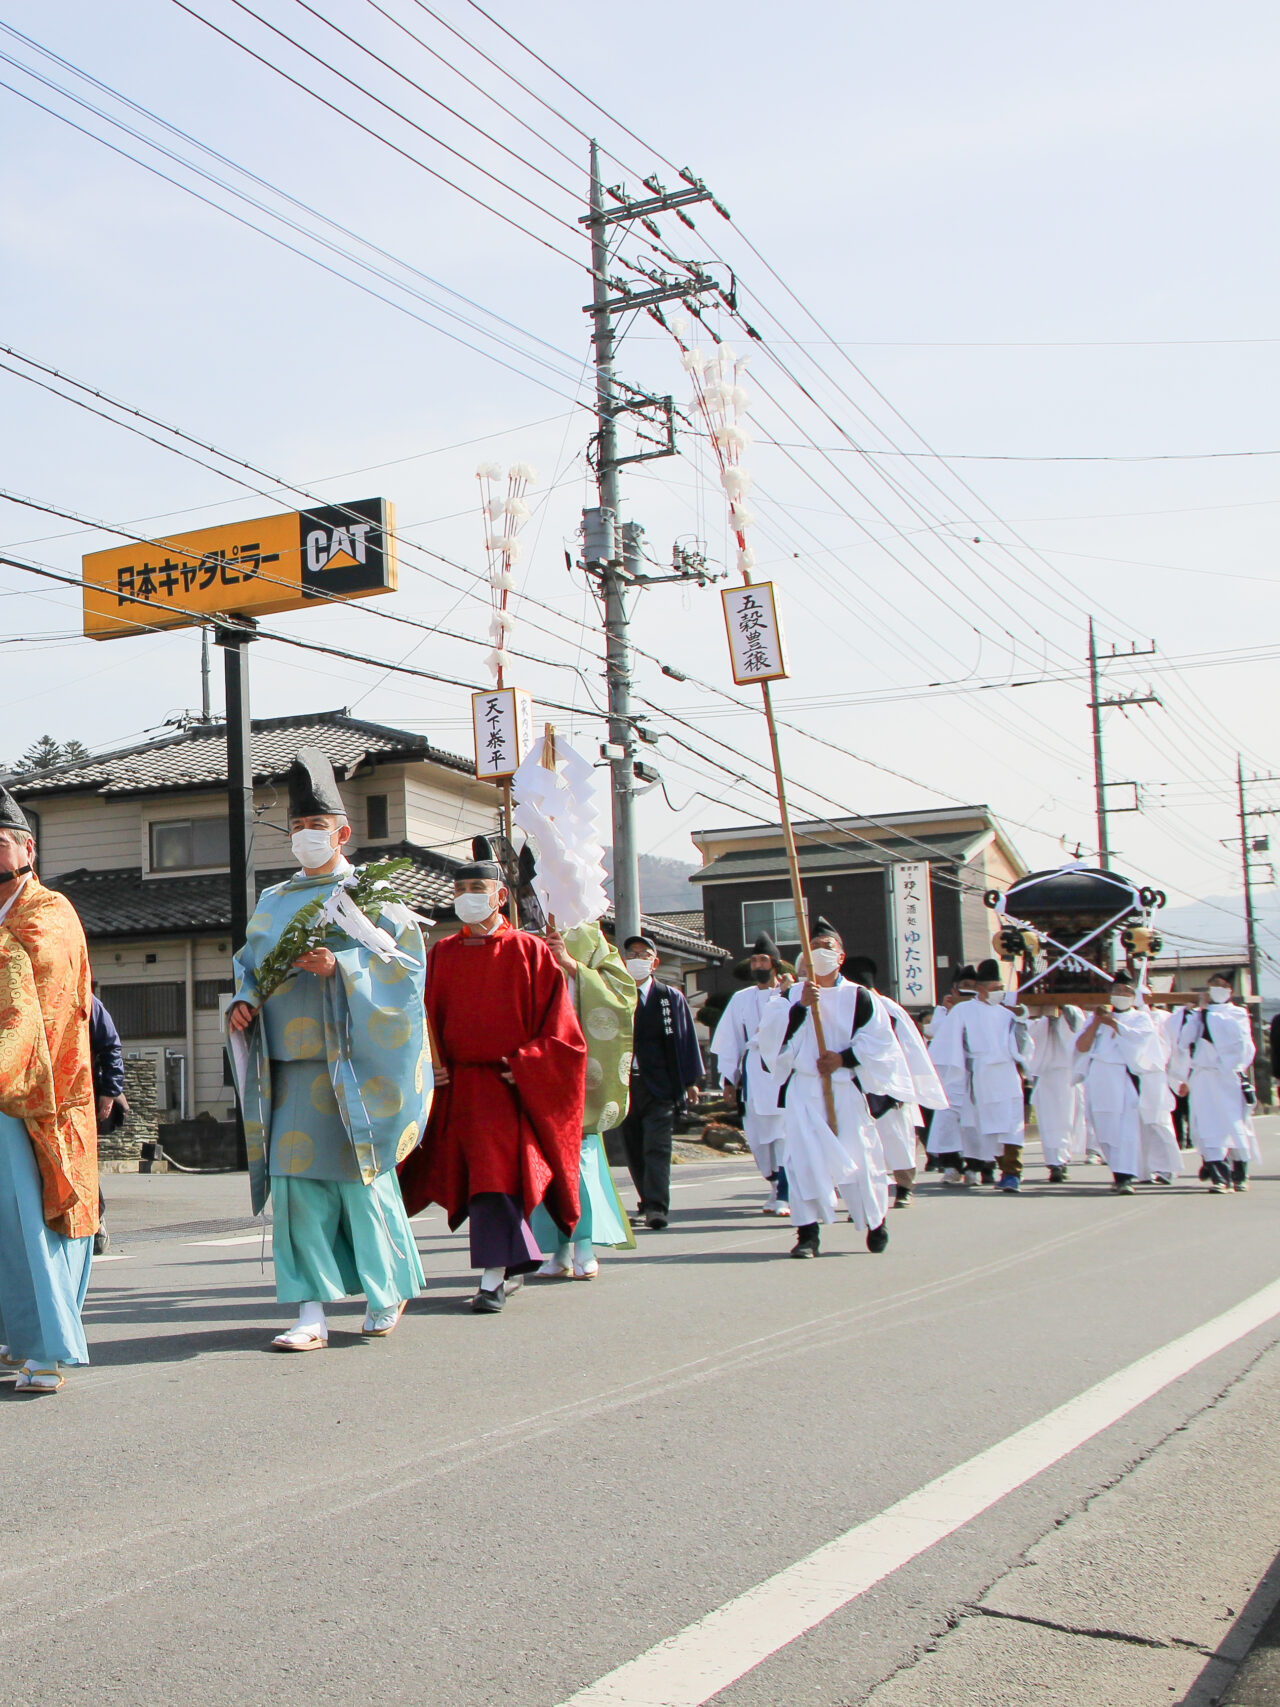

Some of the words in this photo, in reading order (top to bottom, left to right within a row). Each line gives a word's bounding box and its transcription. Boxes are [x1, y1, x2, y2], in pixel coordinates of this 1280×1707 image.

[117, 543, 280, 606] 日本キャタピラー
[306, 523, 371, 572] CAT
